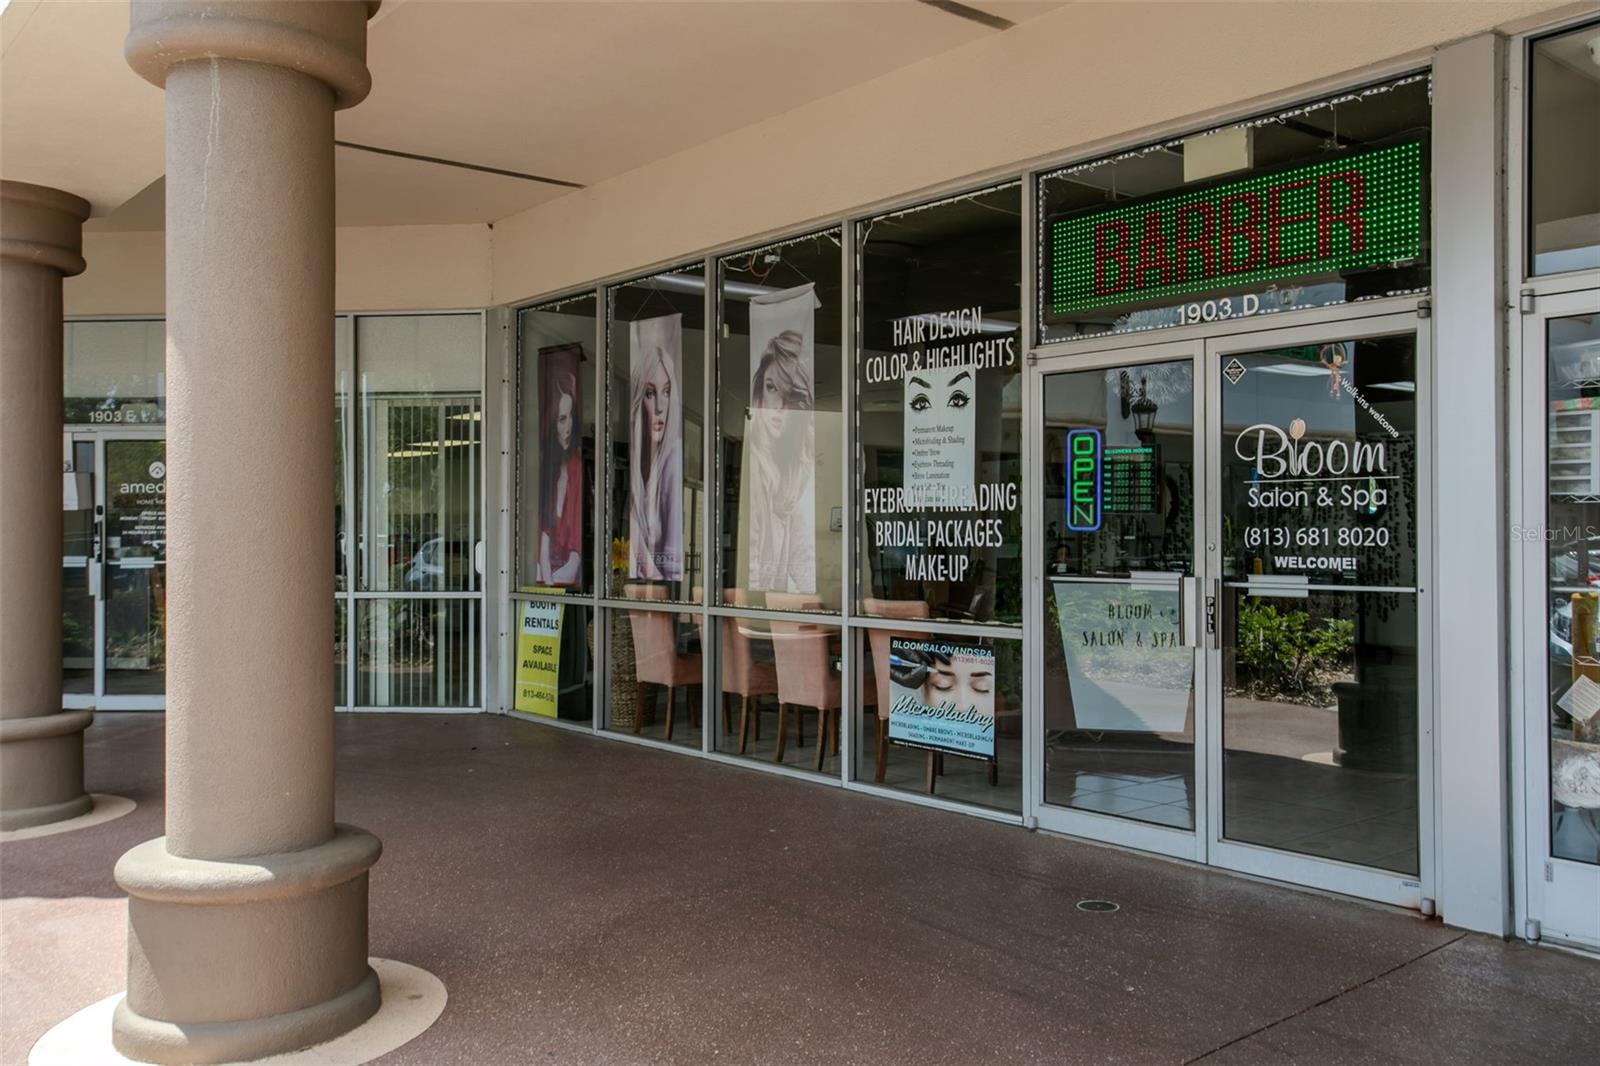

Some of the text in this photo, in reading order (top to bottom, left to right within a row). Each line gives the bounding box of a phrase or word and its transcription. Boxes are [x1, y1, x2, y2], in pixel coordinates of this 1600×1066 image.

[1095, 170, 1364, 297] BARBER
[1177, 294, 1260, 326] 1903 D
[893, 306, 982, 346] HAIR DESIGN
[866, 337, 1014, 383] COLOR & HIGHLIGHTS
[88, 411, 122, 422] 1903
[1341, 377, 1399, 438] Walk-ins welcome
[1235, 418, 1388, 478] Bloom
[1073, 436, 1094, 525] OPEN
[864, 487, 925, 514] EYEBROW
[1248, 484, 1387, 510] Salon & Spa
[875, 519, 1003, 547] BRIDAL PACKAGES
[1244, 526, 1389, 548] (813) 681 8020
[905, 554, 968, 582] MAKE-UP
[1274, 556, 1357, 571] WELCOME!
[524, 617, 559, 630] RENTALS
[1108, 604, 1153, 619] BLOOM
[1206, 597, 1215, 633] PULL
[533, 644, 553, 656] SPACE
[892, 640, 993, 657] BLOOMSALONANDSPA
[1082, 630, 1124, 647] SALON
[1151, 632, 1177, 647] SPA
[523, 660, 556, 672] AVAILABLE
[891, 695, 993, 733] Microblading
